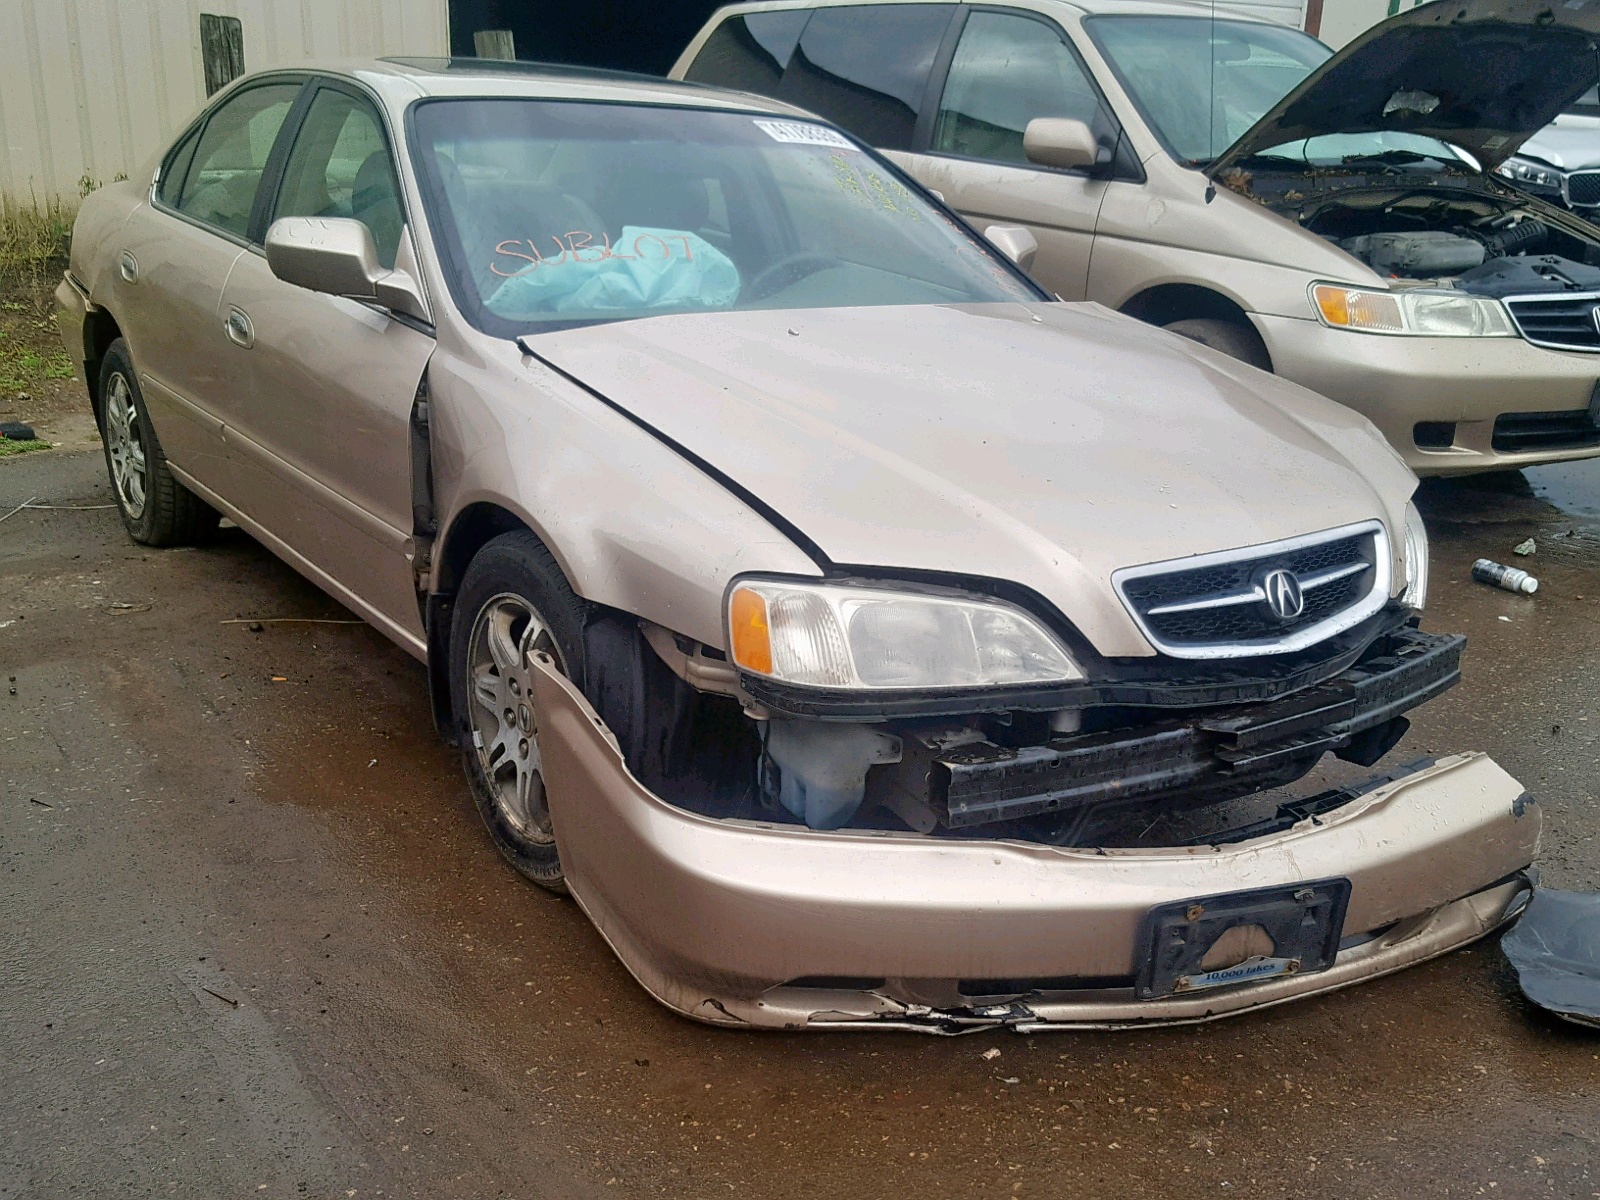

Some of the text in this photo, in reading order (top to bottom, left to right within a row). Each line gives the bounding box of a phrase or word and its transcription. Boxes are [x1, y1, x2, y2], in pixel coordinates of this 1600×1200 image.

[490, 230, 693, 277] SUBLOT
[1206, 963, 1275, 980] 10,000 lakes
